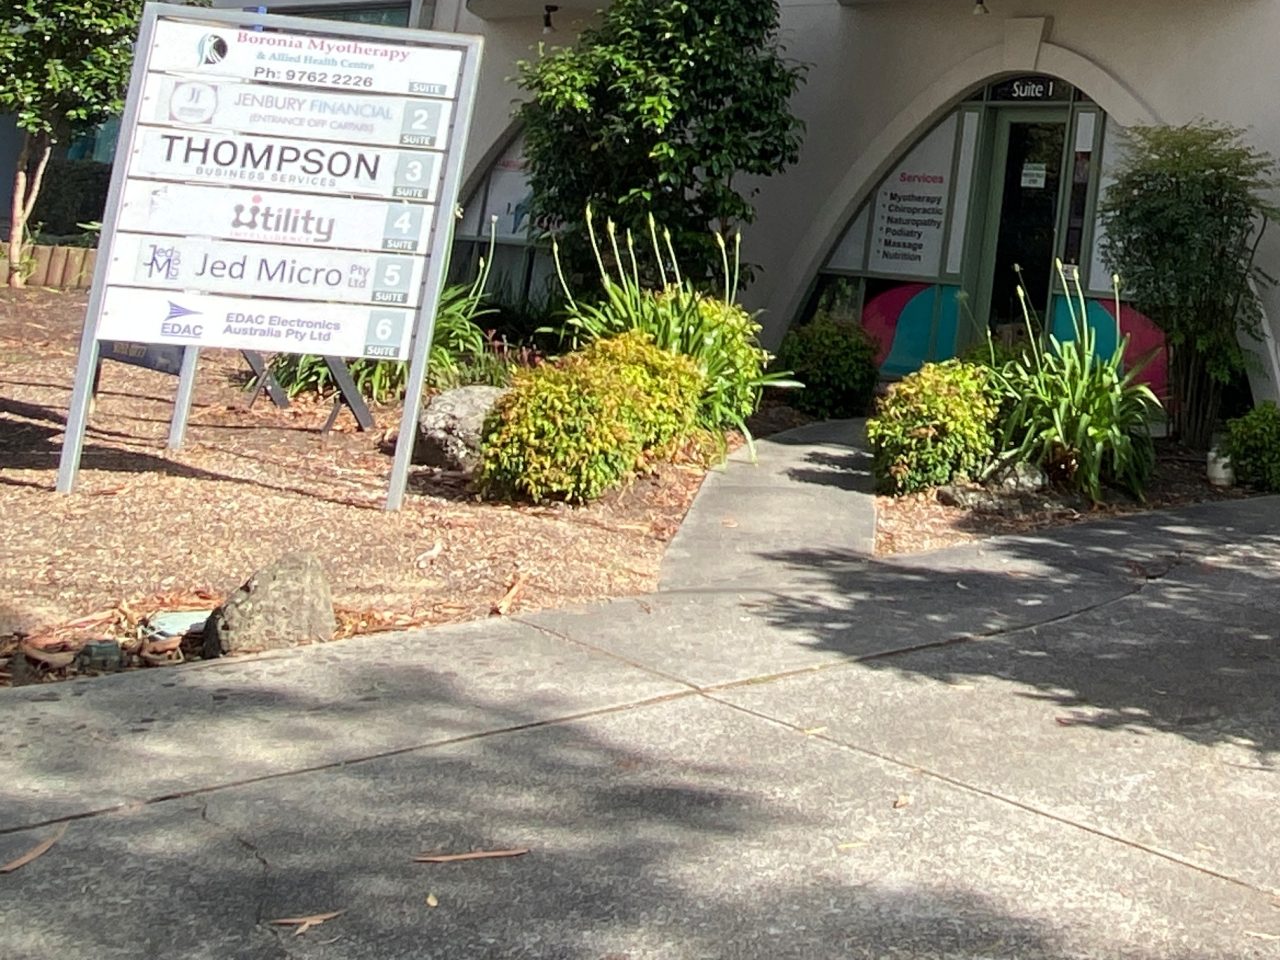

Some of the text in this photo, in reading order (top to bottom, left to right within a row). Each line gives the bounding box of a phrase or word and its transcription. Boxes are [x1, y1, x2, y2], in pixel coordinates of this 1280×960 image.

[237, 31, 411, 61] Boronia Myotherapy
[256, 51, 375, 70] & Allied Health Centre
[253, 66, 374, 87] Ph: 9762 2226
[411, 83, 440, 94] SUITE
[1012, 81, 1054, 97] Suite 1
[234, 92, 307, 113] JENBURY
[309, 98, 393, 121] FINANCIAL
[411, 109, 428, 130] 2
[402, 135, 431, 145] SUITE
[161, 134, 380, 181] THOMPSON
[195, 166, 337, 187] BUSINESS SERVICES
[405, 160, 423, 182] 3
[899, 171, 945, 185] Services
[395, 187, 424, 198] SUITE
[889, 191, 943, 205] Myotherapy
[887, 203, 944, 216] Chiropractic
[393, 211, 412, 234] 4
[886, 215, 943, 230] Naturopathy
[884, 226, 923, 240] Podiatry
[386, 239, 414, 250] SUITE
[883, 238, 924, 252] Massage
[881, 249, 922, 262] Nutrition
[195, 253, 248, 279] Jed
[256, 258, 342, 286] Micro
[350, 264, 371, 278] Pty
[383, 265, 401, 286] 5
[348, 276, 367, 289] Ltd
[375, 292, 405, 303] SUITE
[225, 312, 342, 331] EDAC Electronics
[375, 318, 393, 340] 6
[160, 322, 203, 337] EDAC
[223, 324, 331, 342] Australia Pty Ltd
[367, 345, 397, 356] SUITE
